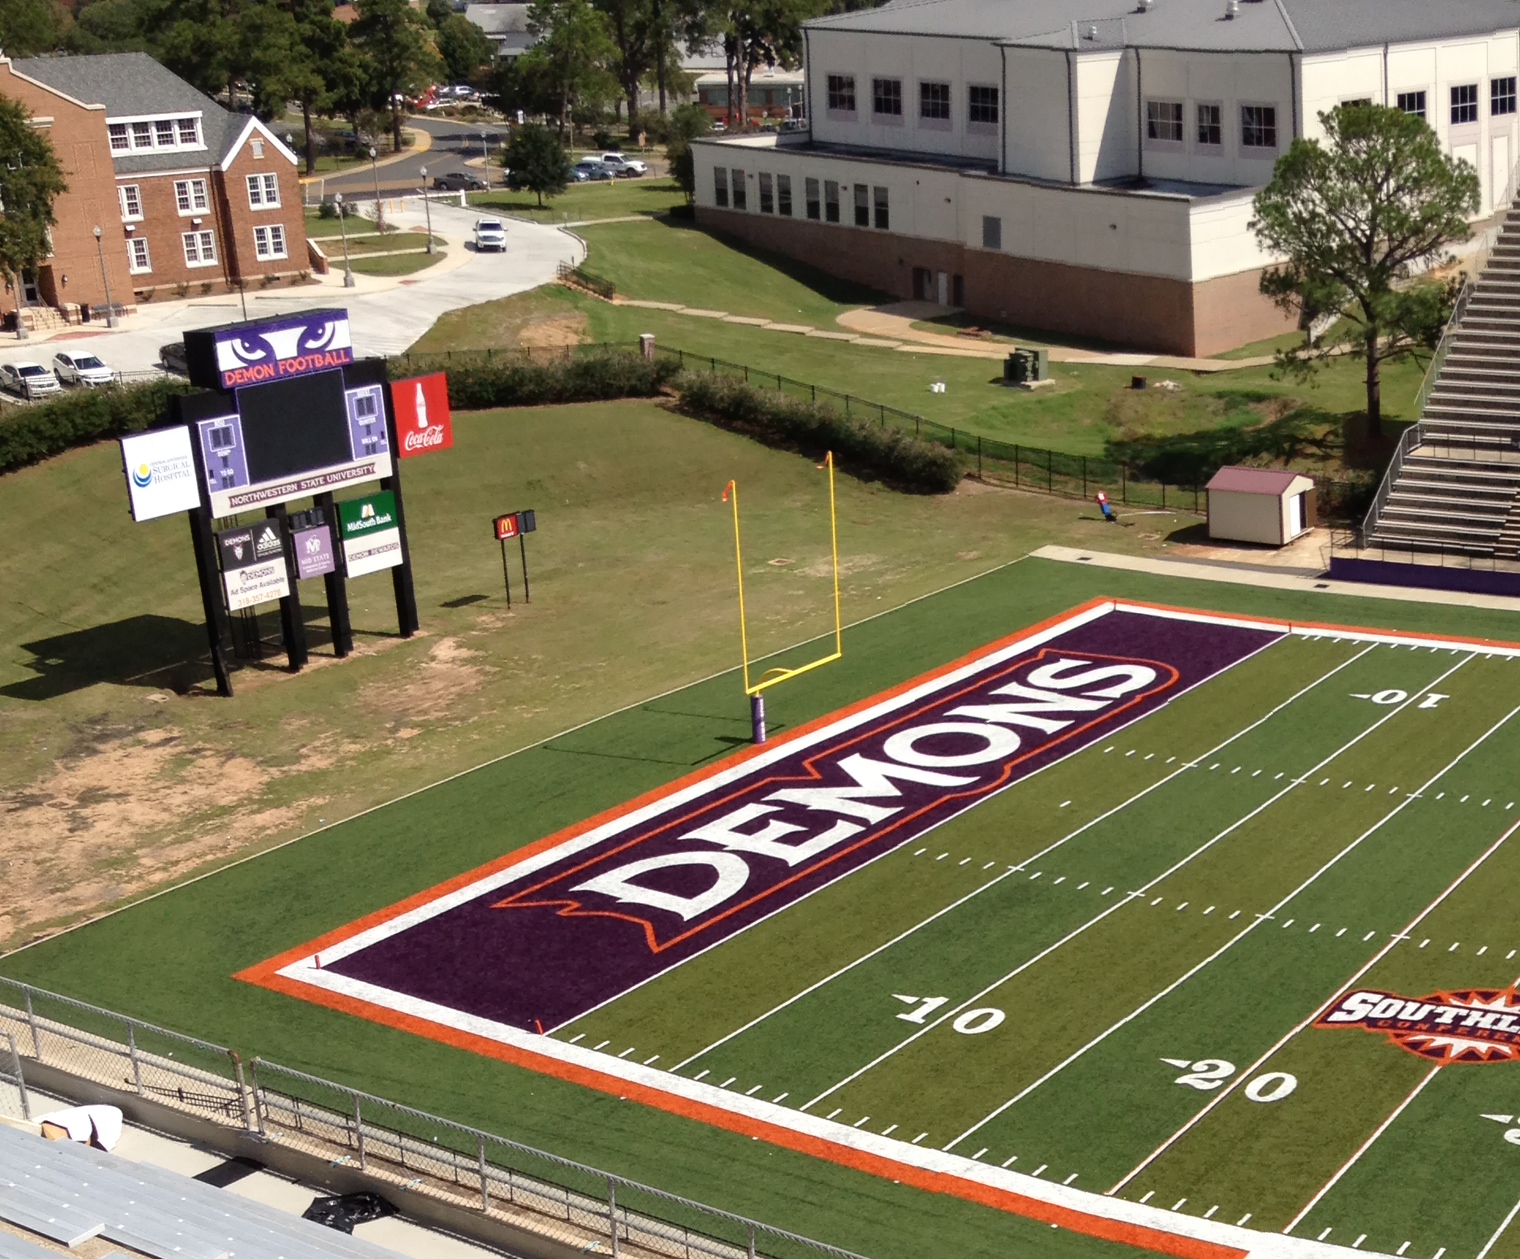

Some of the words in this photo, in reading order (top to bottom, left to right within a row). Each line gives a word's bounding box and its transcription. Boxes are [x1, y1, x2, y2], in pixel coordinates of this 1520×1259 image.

[224, 363, 275, 387] DEMON
[279, 350, 350, 376] FOOTBALL
[405, 424, 444, 452] Coca-Cola
[153, 469, 192, 484] HOSPITAL
[231, 483, 299, 506] NORTHWESTERN
[301, 475, 326, 489] STATE
[326, 464, 375, 484] UNIVERSITY
[346, 518, 377, 532] MidSouth
[376, 513, 392, 526] Bank
[224, 534, 251, 546] DEMONS
[257, 538, 280, 550] adidas
[1370, 688, 1450, 710] 10
[569, 658, 1157, 921] DEMONS
[895, 995, 1007, 1035] 10
[1176, 1058, 1299, 1104] 20
